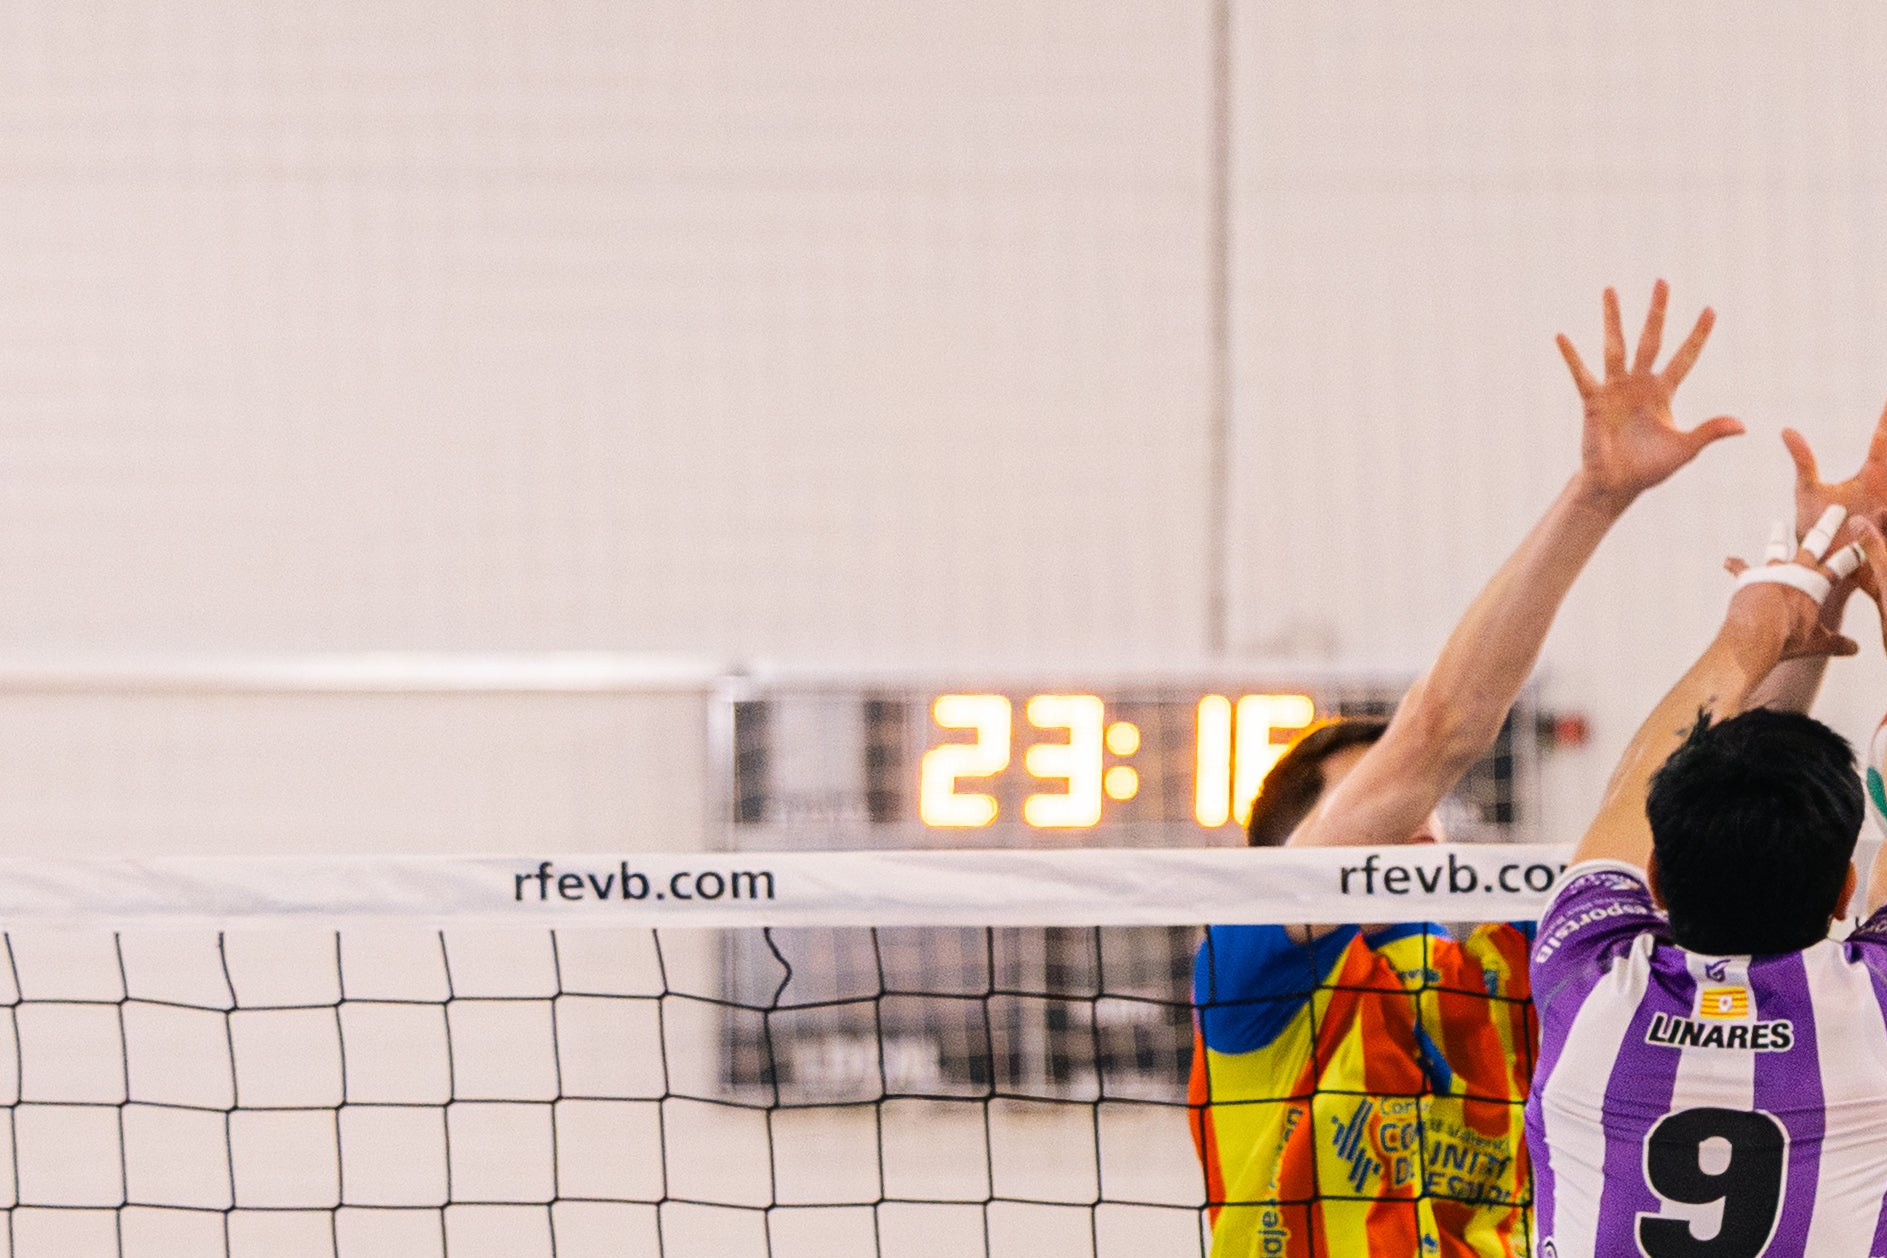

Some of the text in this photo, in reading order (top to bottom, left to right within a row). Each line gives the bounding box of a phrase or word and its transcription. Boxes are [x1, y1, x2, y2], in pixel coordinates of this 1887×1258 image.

[515, 861, 774, 901] rfevb.com
[1340, 853, 1567, 894] rfevb.co
[1647, 1014, 1793, 1050] LINARES
